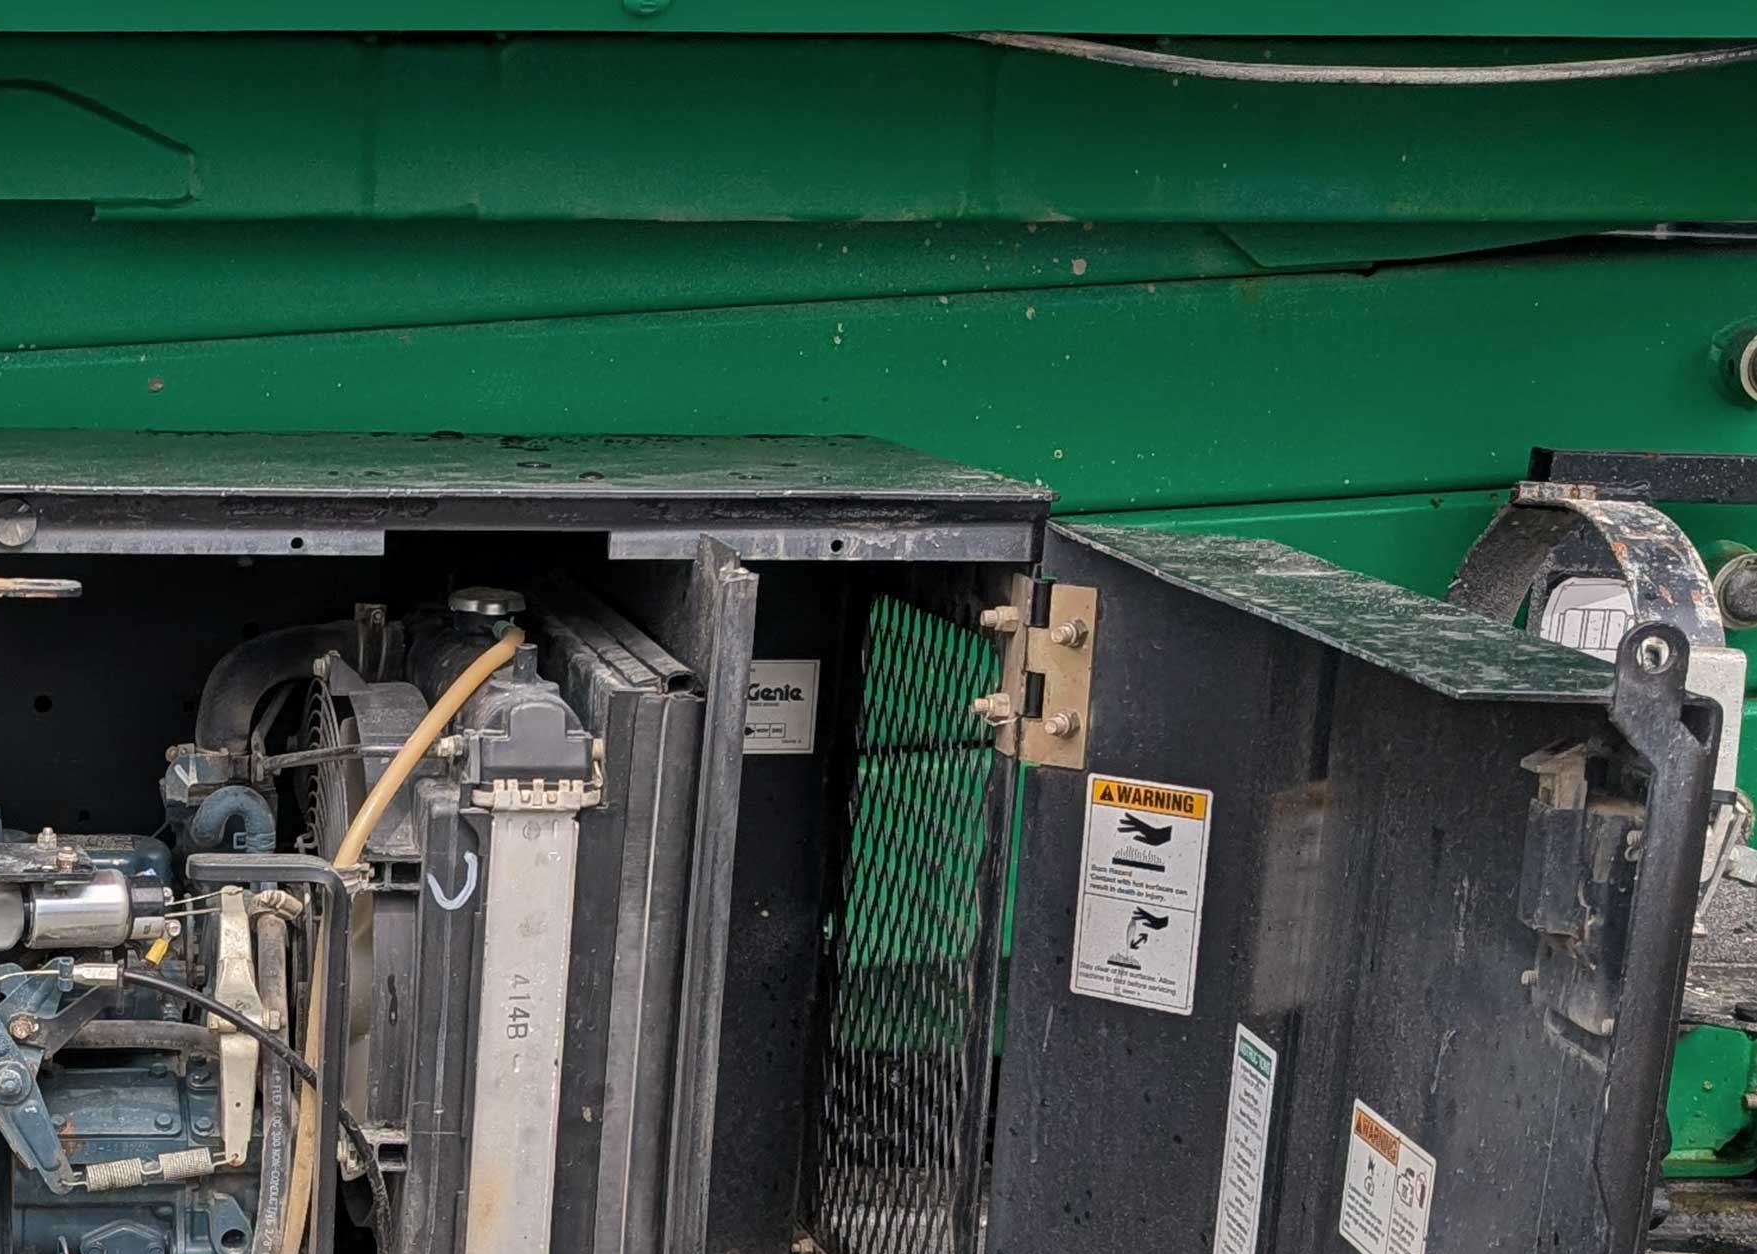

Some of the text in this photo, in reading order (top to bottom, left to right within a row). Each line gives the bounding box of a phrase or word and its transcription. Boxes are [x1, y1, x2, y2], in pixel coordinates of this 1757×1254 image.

[747, 683, 804, 702] Genie
[1116, 784, 1195, 814] WARNING
[506, 973, 531, 1040] 414B
